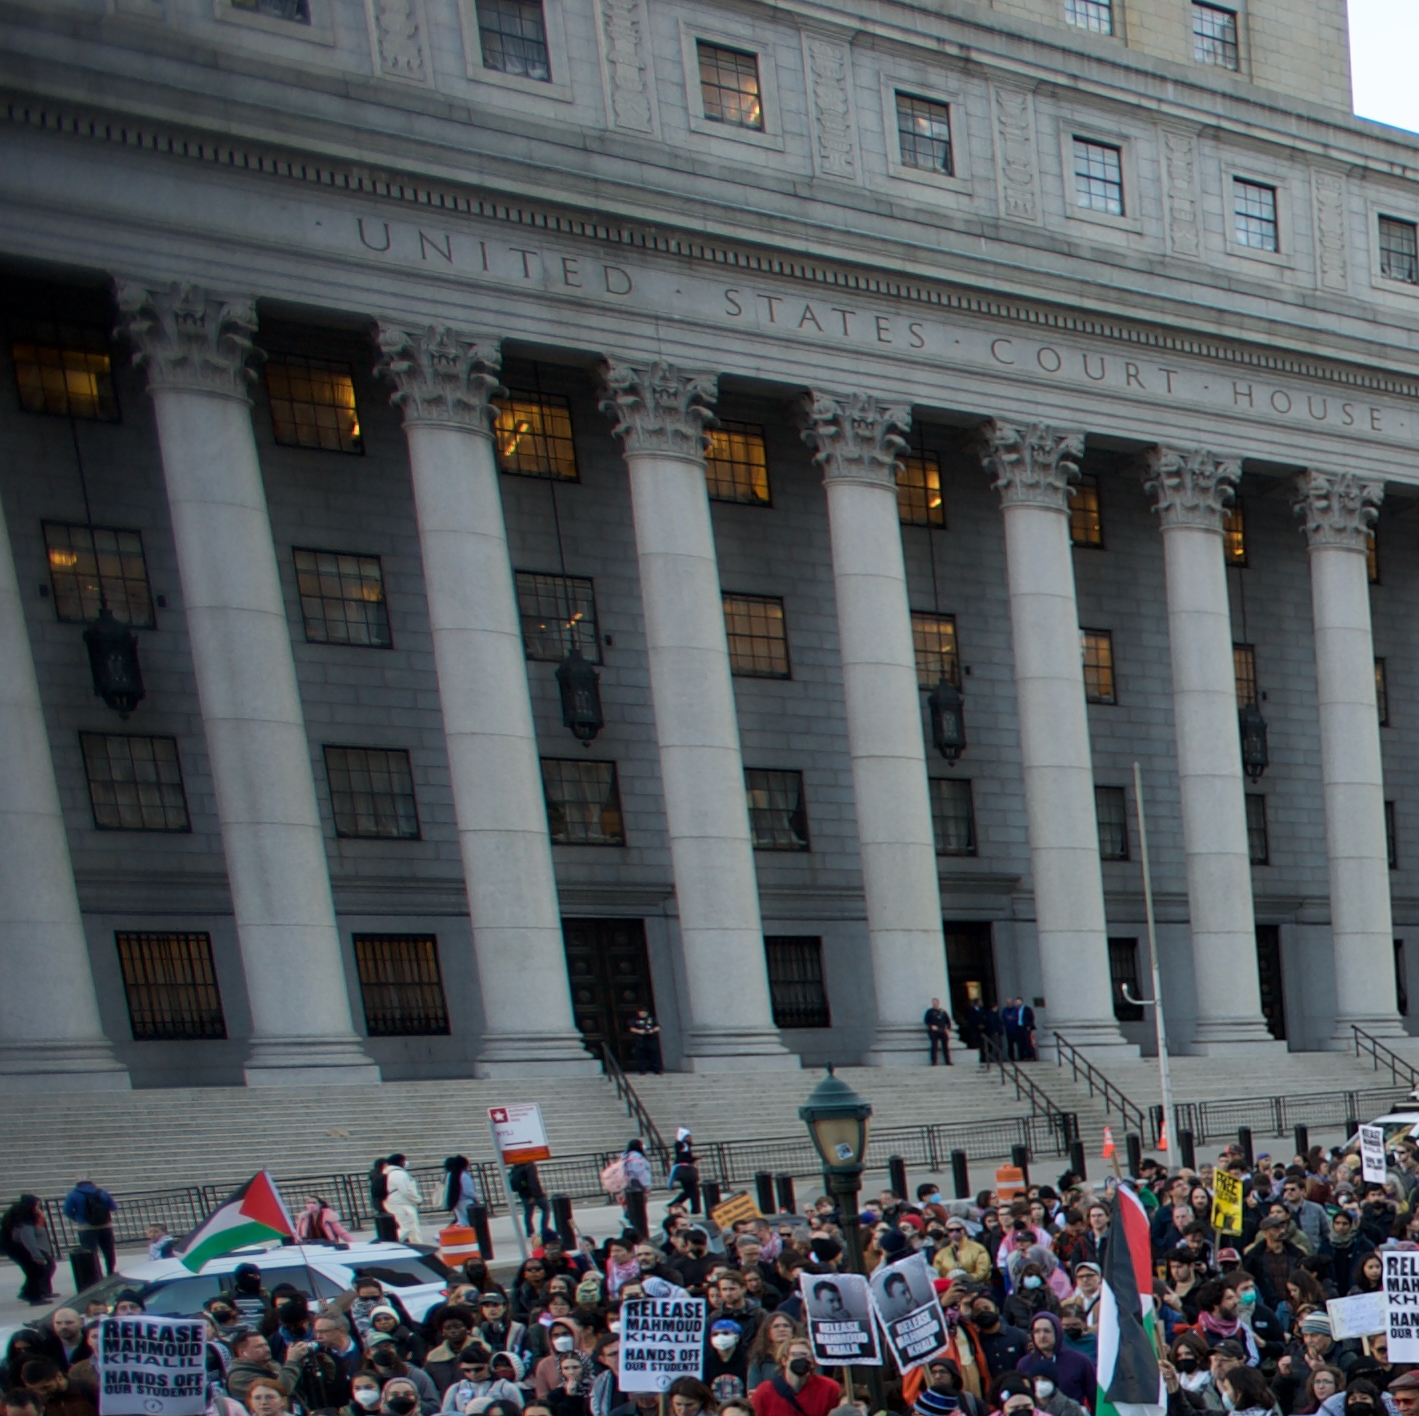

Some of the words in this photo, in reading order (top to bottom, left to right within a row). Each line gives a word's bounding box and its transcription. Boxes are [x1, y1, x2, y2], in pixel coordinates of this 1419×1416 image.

[356, 216, 635, 297] UNITED
[725, 287, 928, 349] STATES
[990, 336, 1179, 396] COURT
[1231, 379, 1385, 433] HOUSE
[627, 1302, 703, 1318] RELEASE
[103, 1321, 203, 1342] RELEASE
[626, 1320, 701, 1332] MAHMOUD
[626, 1333, 700, 1343] KHALIL
[1391, 1328, 1413, 1338] OUR
[103, 1339, 201, 1356] MAHMOUD
[103, 1354, 202, 1367] KHALIL
[626, 1350, 676, 1361] HANDS
[682, 1350, 700, 1361] OFF
[625, 1363, 646, 1371] OUR
[650, 1363, 700, 1372] STUDENTS
[105, 1371, 169, 1387] HANDS
[175, 1374, 203, 1387] OFF
[105, 1383, 131, 1394] OUR
[137, 1384, 203, 1397] STUDENTS
